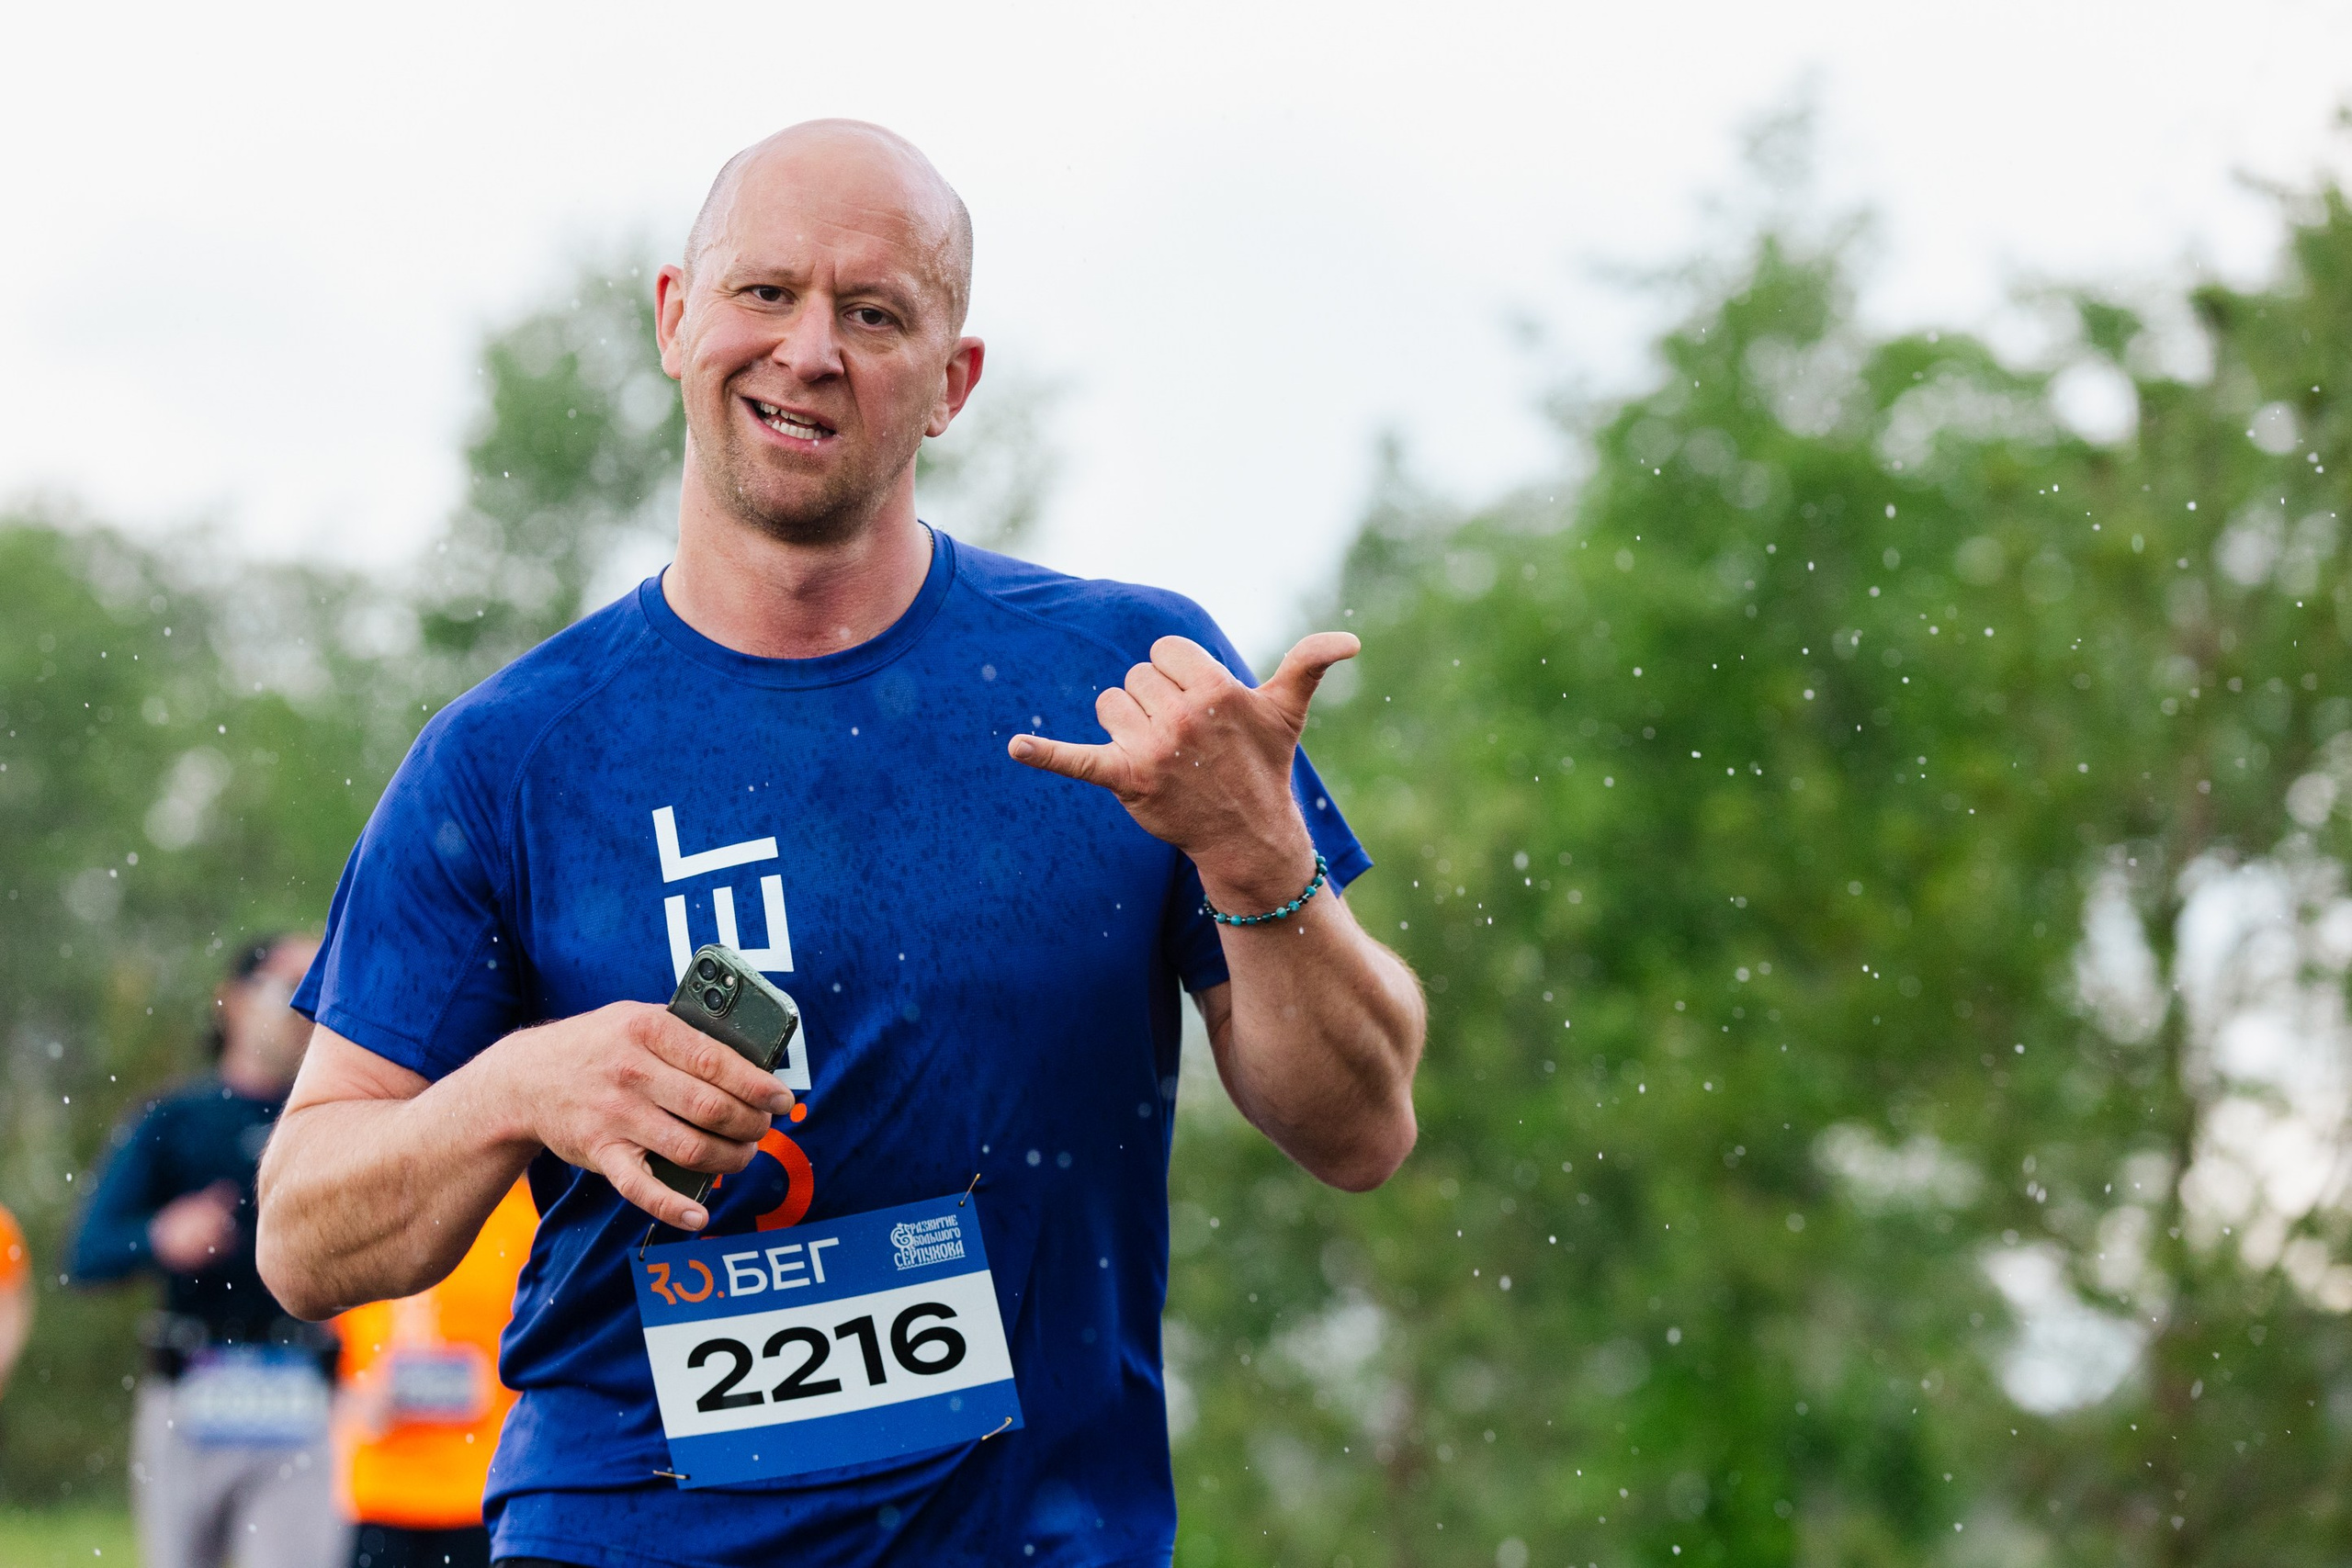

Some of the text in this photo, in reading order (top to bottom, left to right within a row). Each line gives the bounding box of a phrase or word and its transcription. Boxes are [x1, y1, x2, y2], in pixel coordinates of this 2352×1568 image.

[909, 1214, 958, 1234] РАЗВИТИЕ
[912, 1227, 961, 1247] БОЛЬШОГО
[894, 1240, 965, 1267] СЕРПУХОВА
[687, 1302, 967, 1413] 2216
